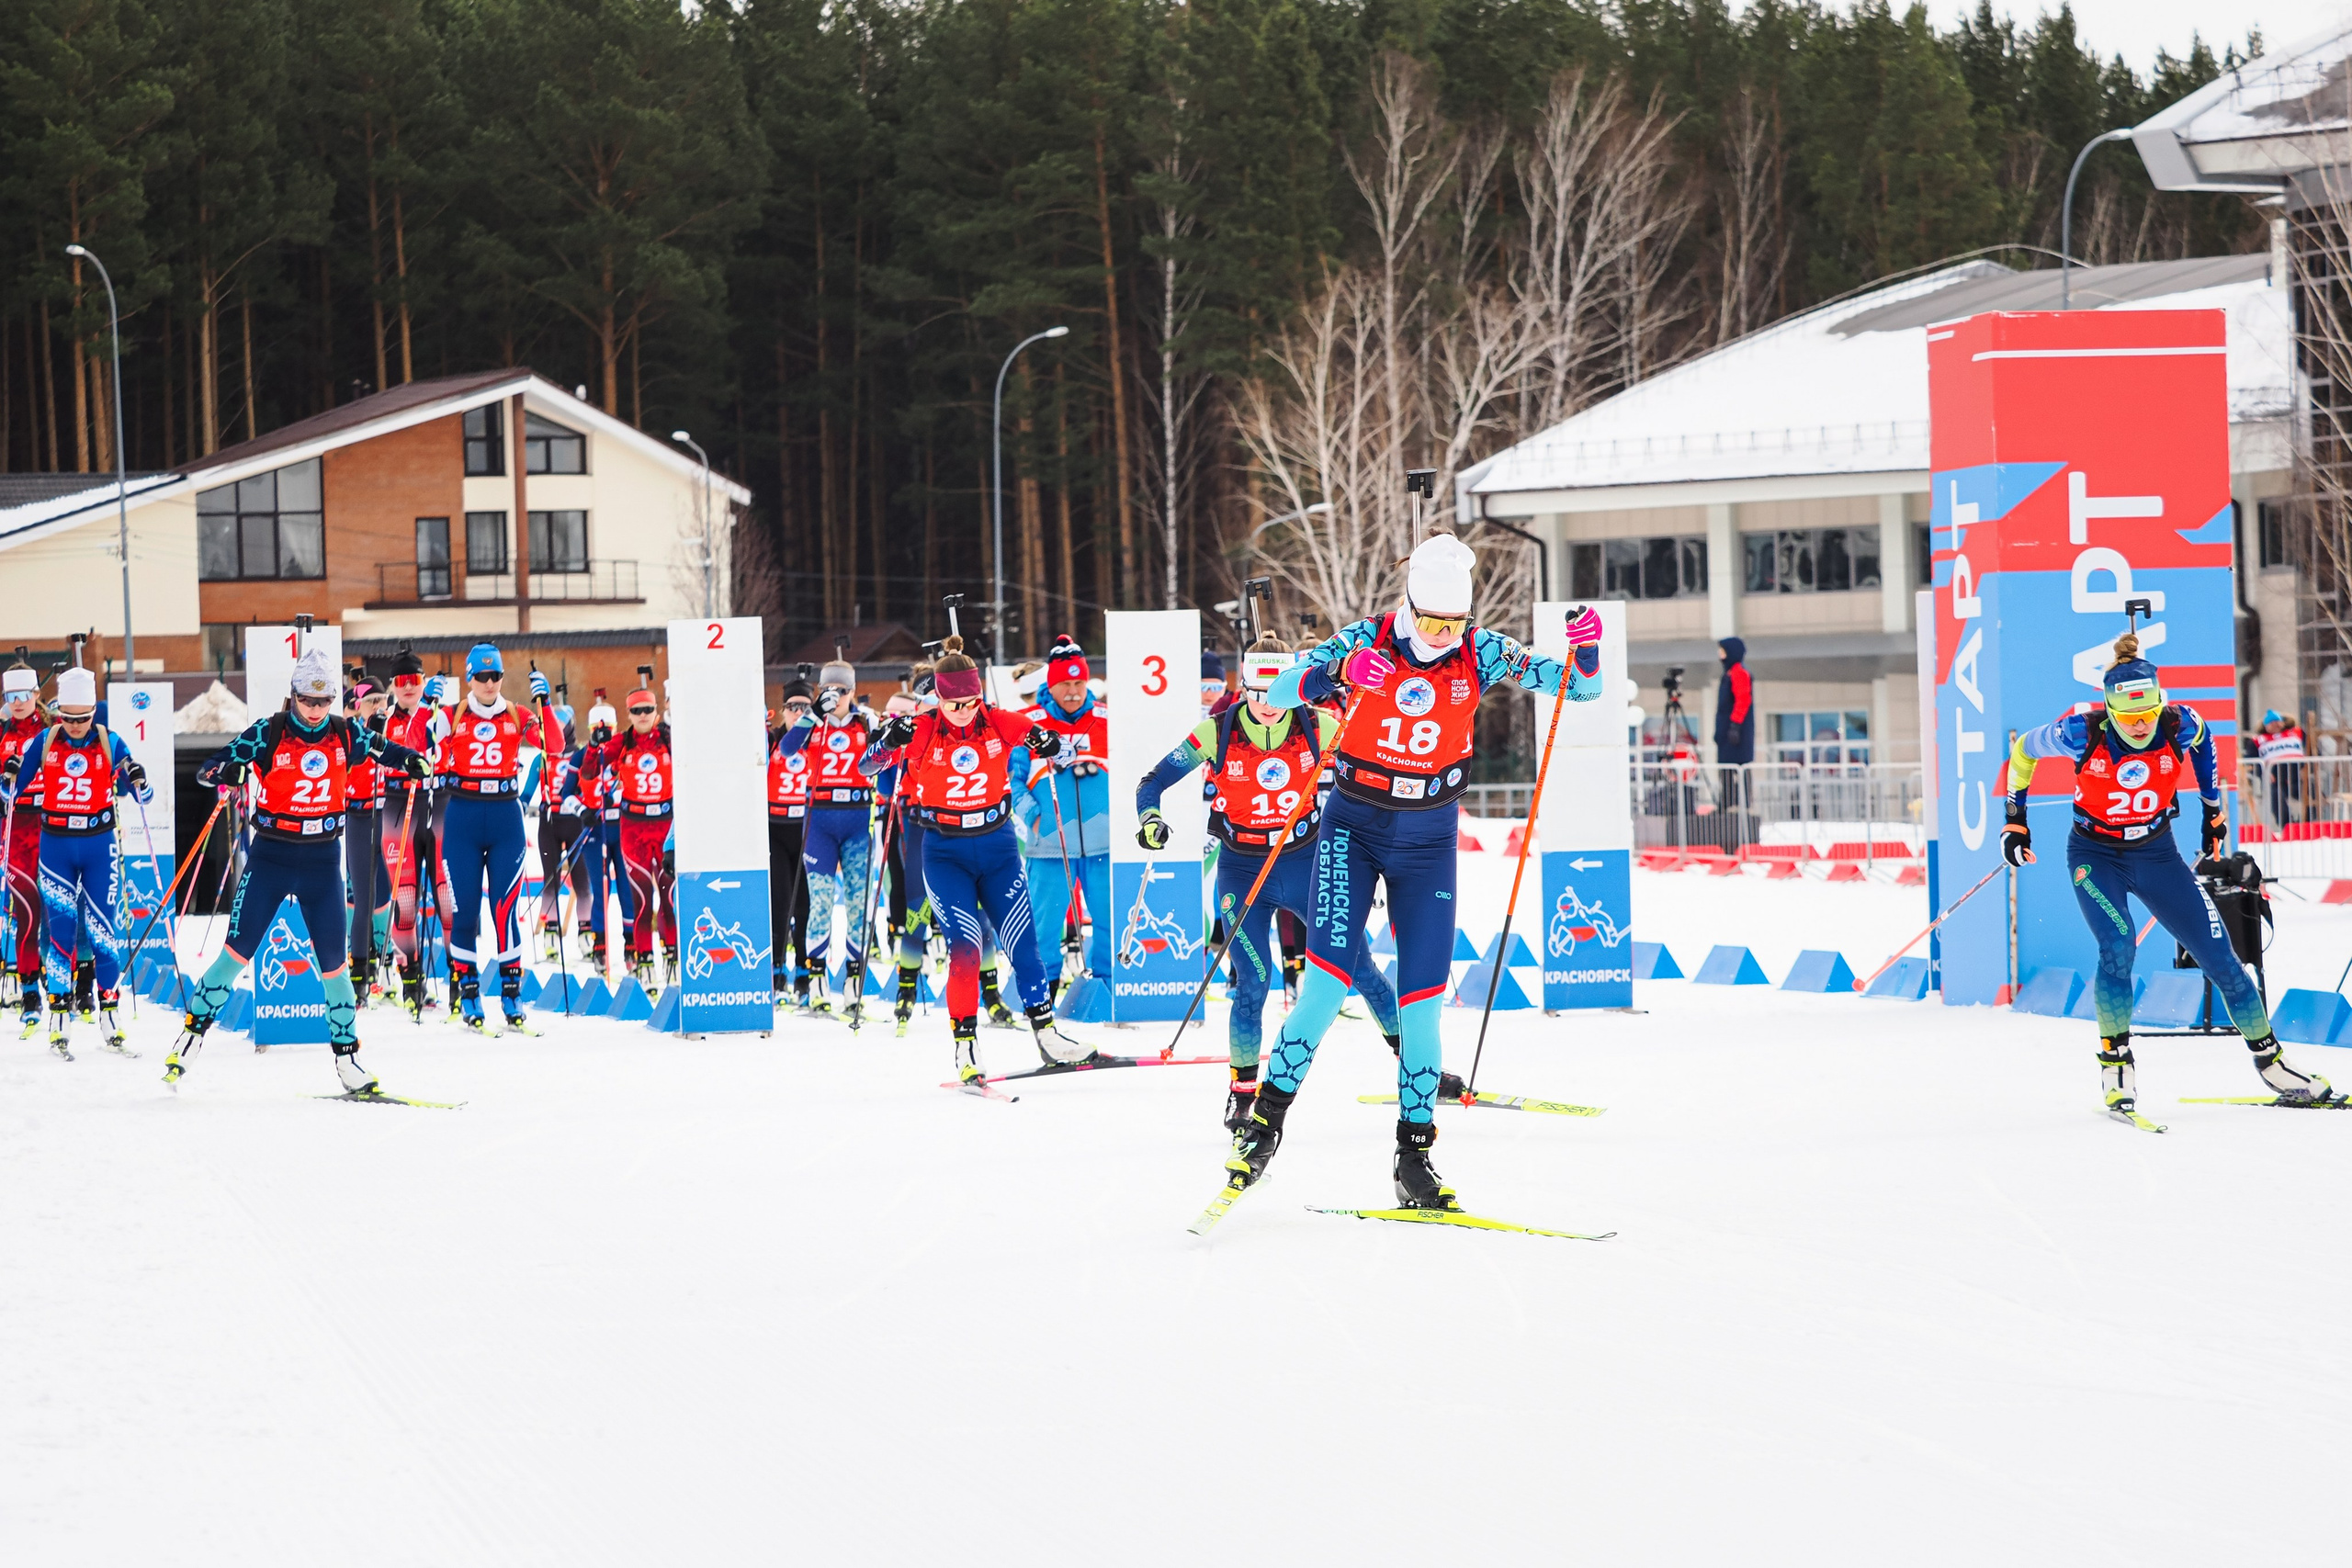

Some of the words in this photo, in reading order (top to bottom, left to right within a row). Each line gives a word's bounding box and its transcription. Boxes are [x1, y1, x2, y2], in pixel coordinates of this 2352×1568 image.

[285, 632, 298, 659] 1
[707, 623, 724, 649] 2
[1141, 655, 1168, 696] 3
[1950, 479, 1988, 852] СТАРТ
[135, 719, 145, 741] 1
[1377, 717, 1442, 755] 18
[469, 742, 503, 766] 26
[821, 752, 855, 776] 27
[1376, 751, 1433, 769] КРАСНОЯРСК
[57, 776, 92, 802] 25
[291, 778, 331, 804] 21
[634, 773, 662, 794] 39
[945, 773, 989, 798] 22
[1251, 790, 1301, 817] 19
[2106, 789, 2159, 816] 20
[107, 843, 119, 906] ЯМАЛ
[1315, 840, 1331, 929] ОБЛАСТЬ
[1330, 828, 1351, 948] ТЮМЕНСКАЯ
[1544, 969, 1631, 985] КРАСНОЯРСК
[256, 1003, 326, 1019] КРАСНОЯР
[683, 990, 771, 1007] КРАСНОЯРСК
[2257, 1038, 2271, 1049] 170
[1536, 1102, 1588, 1114] FISCHER
[1410, 1134, 1427, 1144] 168
[1417, 1211, 1444, 1219] FISCHER
